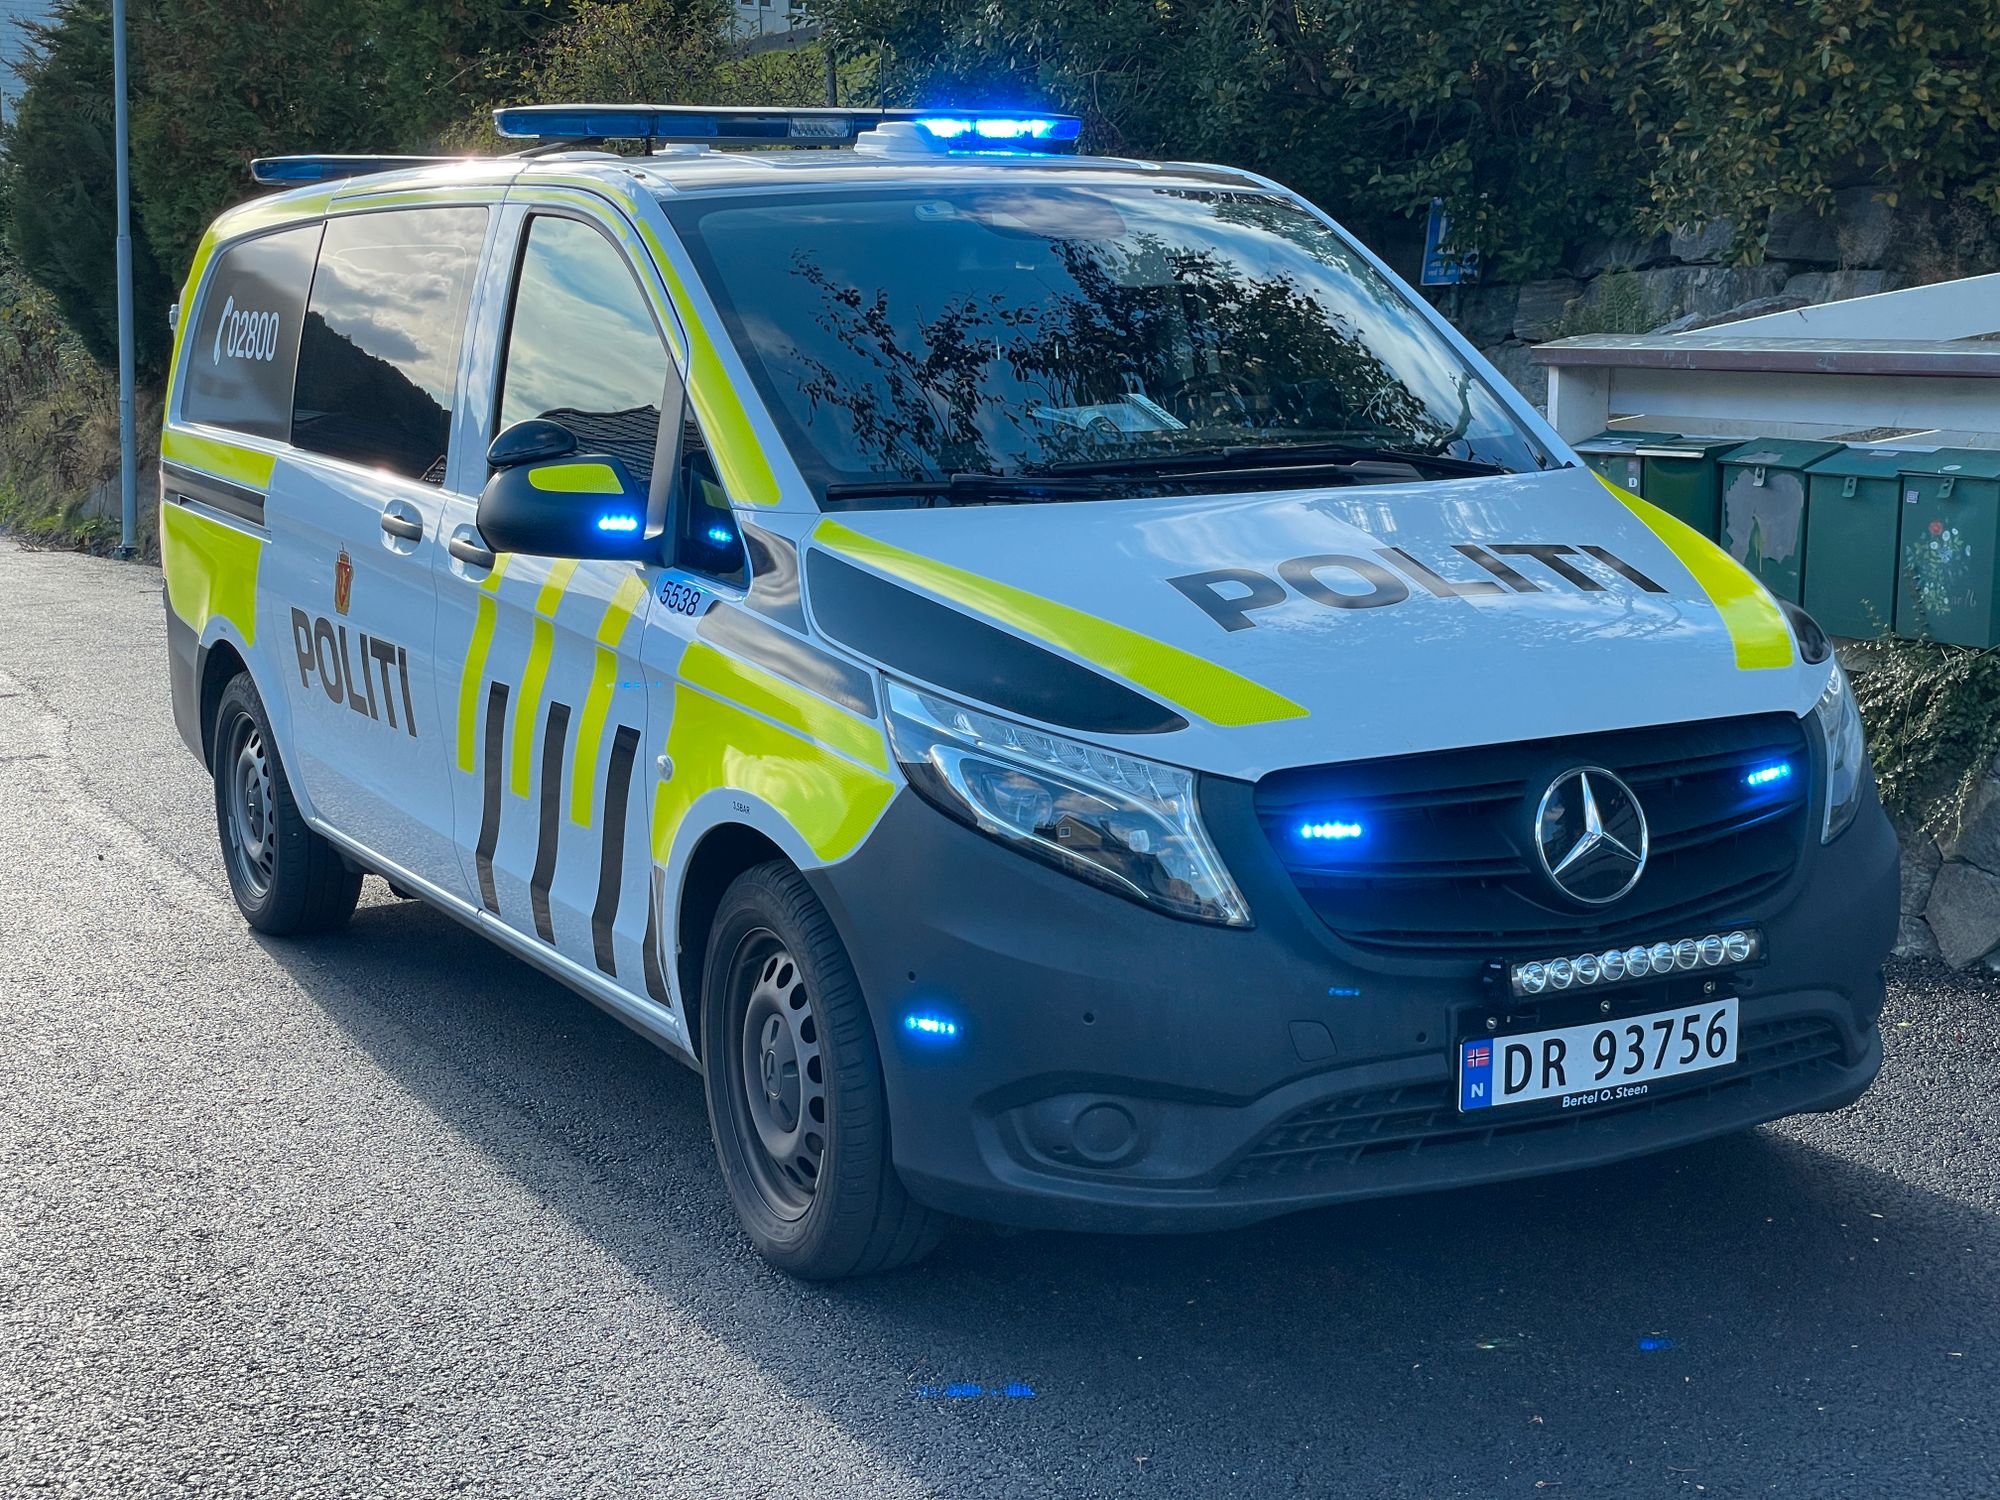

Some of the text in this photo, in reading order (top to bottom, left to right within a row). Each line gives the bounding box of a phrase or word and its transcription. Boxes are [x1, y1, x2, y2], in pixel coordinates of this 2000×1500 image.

[227, 310, 280, 361] 02800
[660, 580, 701, 616] 5538
[1165, 544, 1669, 632] POLITI
[291, 606, 417, 738] POLITI
[1504, 1008, 1727, 1095] DR 93756
[1470, 1082, 1484, 1099] N
[1562, 1085, 1648, 1108] Bertel O. Steen
